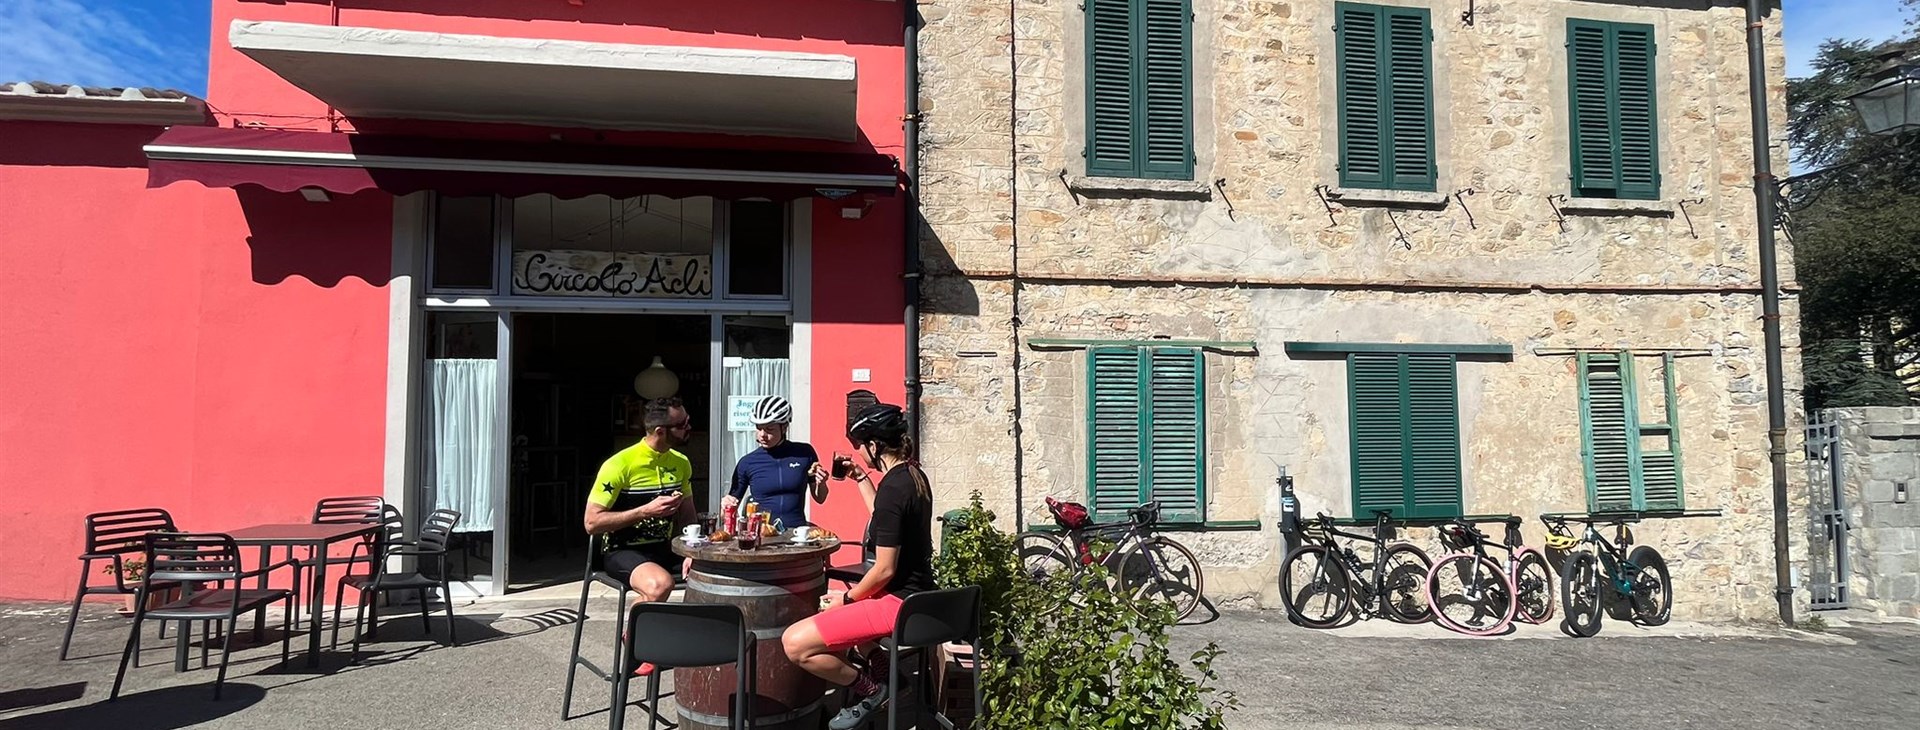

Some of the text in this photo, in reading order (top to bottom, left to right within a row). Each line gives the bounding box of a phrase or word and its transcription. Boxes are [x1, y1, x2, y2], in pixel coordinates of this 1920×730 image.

[515, 253, 712, 295] Circolo Acli
[736, 399, 755, 409] Ingr
